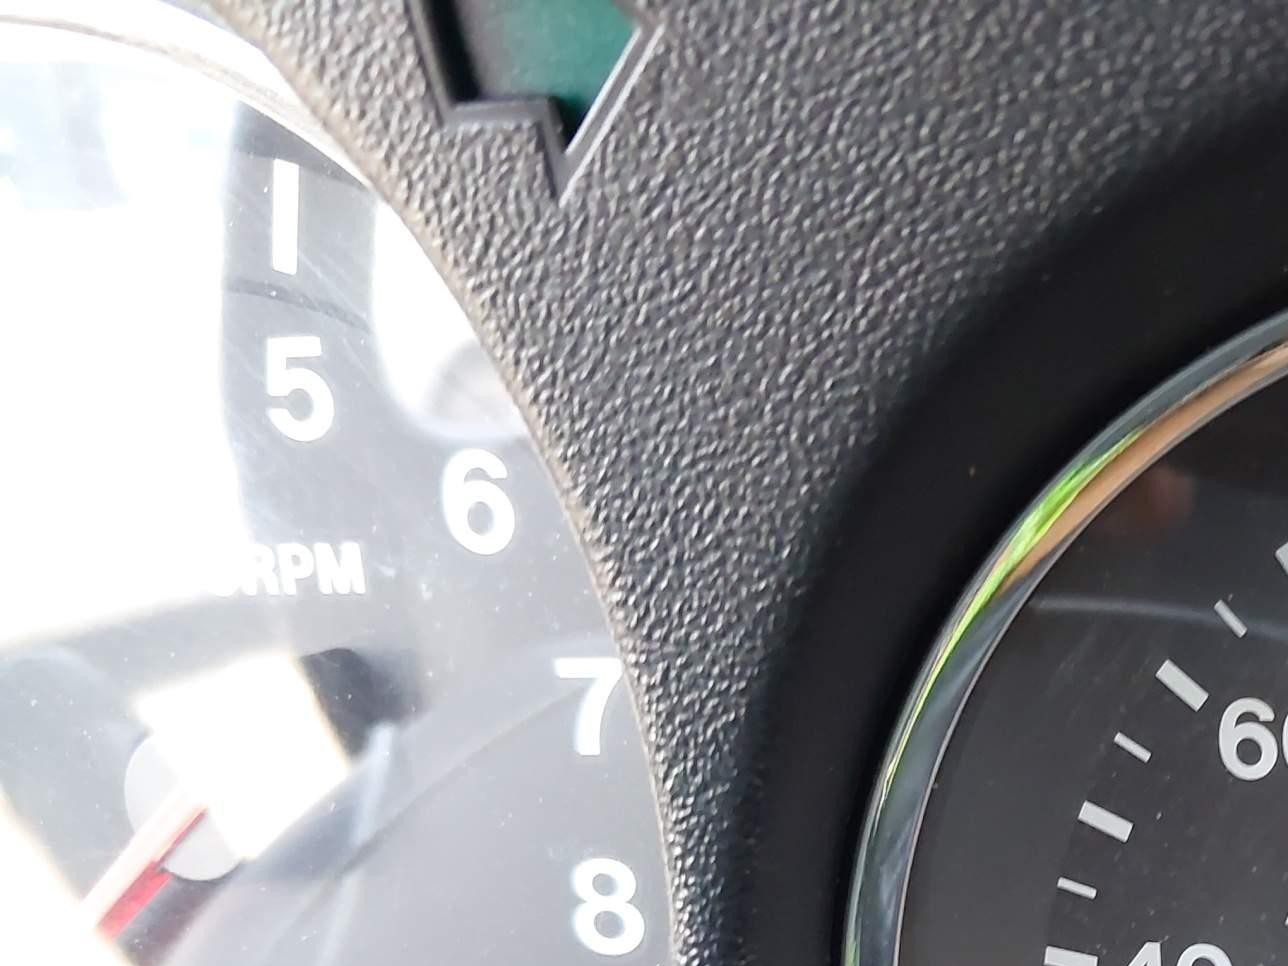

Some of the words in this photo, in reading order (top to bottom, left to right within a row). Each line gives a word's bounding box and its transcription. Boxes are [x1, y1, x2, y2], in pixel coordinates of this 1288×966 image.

[265, 335, 335, 442] 5
[441, 447, 516, 555] 6
[206, 541, 366, 597] RPM
[553, 657, 624, 756] 7
[569, 857, 645, 957] 8
